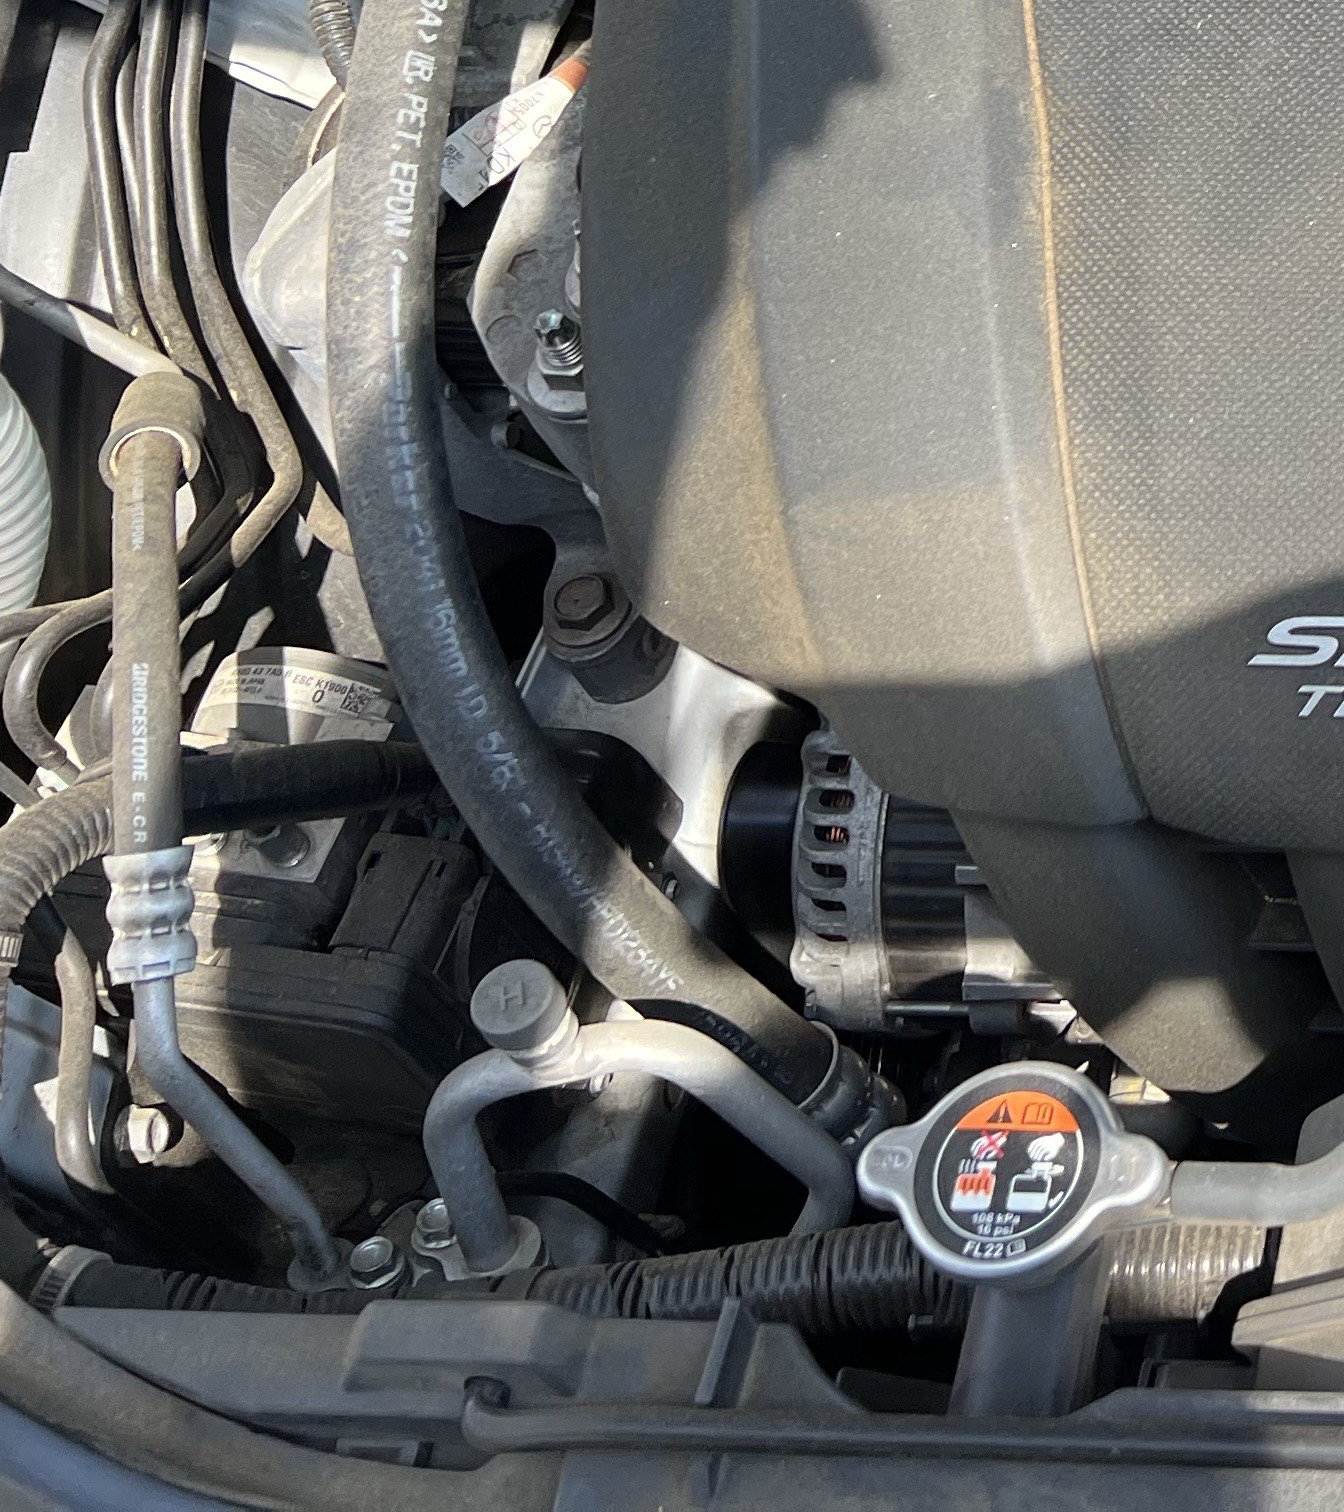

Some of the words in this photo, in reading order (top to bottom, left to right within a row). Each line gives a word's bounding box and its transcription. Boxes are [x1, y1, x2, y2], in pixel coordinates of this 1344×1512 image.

[131, 662, 149, 782] BRIDGESTONE
[500, 981, 529, 1009] H
[996, 1212, 1021, 1225] kPa
[962, 1239, 1004, 1258] FL22
